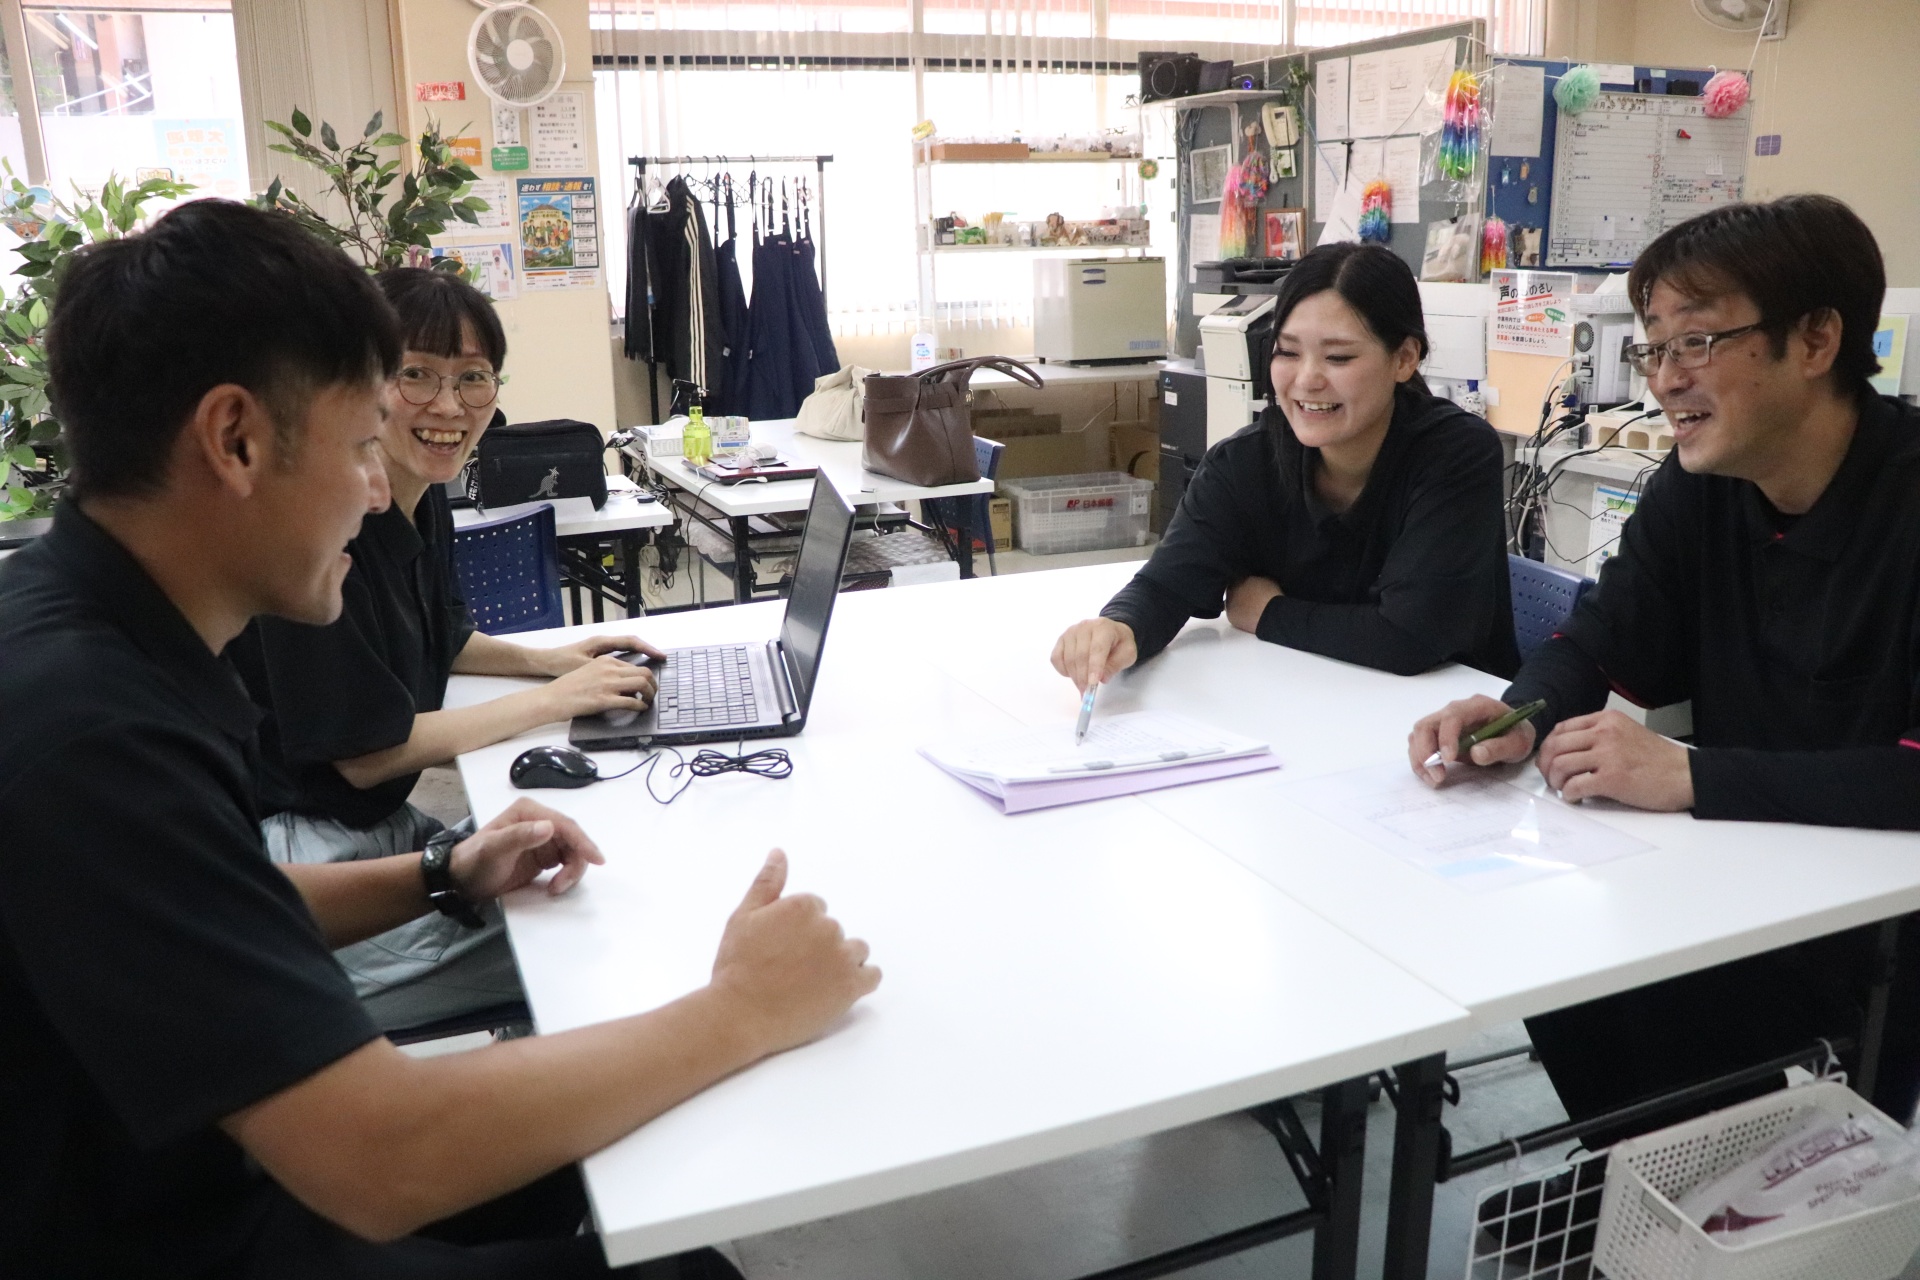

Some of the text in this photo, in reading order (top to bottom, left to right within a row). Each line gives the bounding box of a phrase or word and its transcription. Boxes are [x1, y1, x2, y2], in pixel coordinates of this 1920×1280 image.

[1499, 282, 1552, 300] 声ののさし
